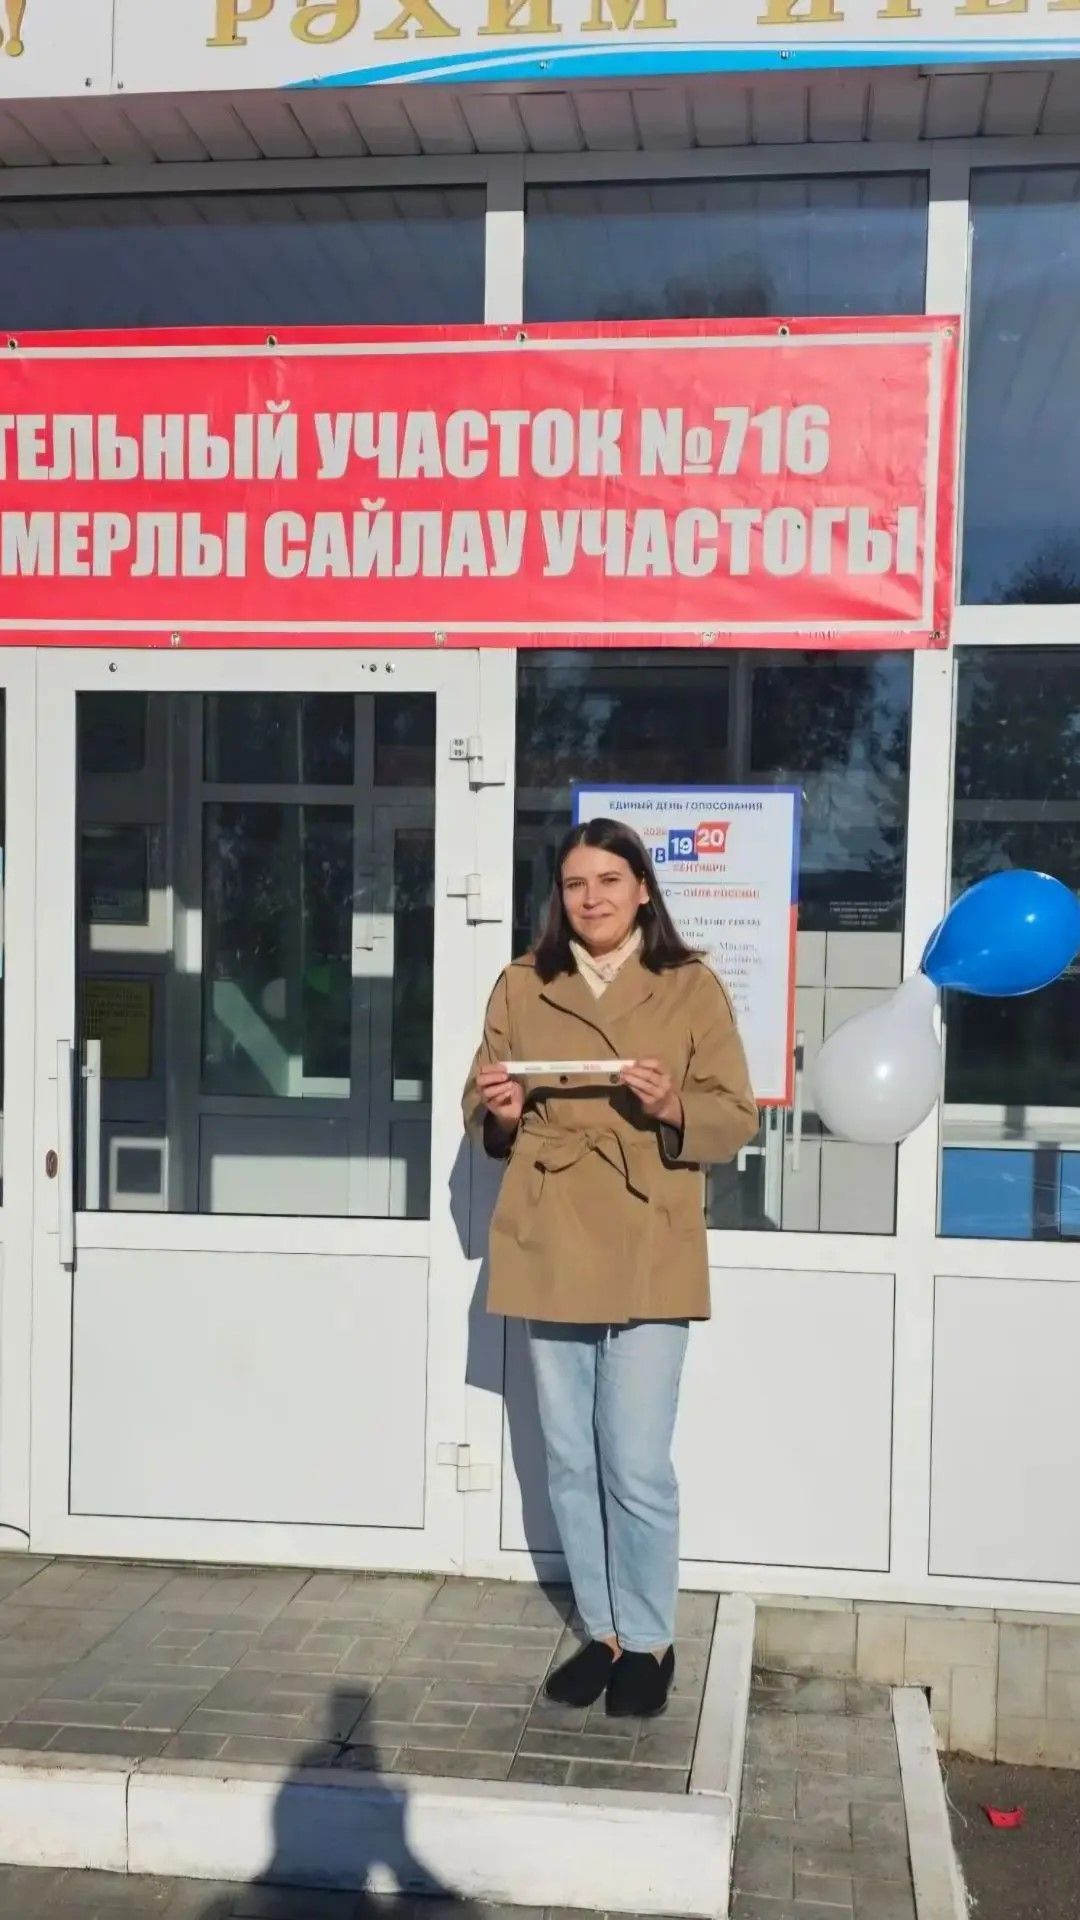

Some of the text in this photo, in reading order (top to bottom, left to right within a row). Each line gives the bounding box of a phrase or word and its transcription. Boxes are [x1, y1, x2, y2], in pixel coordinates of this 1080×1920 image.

[315, 408, 623, 480] УЧАСТОК
[640, 405, 830, 476] №716
[1, 498, 918, 578] МЕРЛЫ САЙЛАУ УЧАСТОГЫ
[609, 800, 763, 811] ЕДИНЫЙ ДЕНЬ ГОЛОСОВАНИЯ
[671, 837, 693, 855] 19
[697, 828, 724, 848] 20
